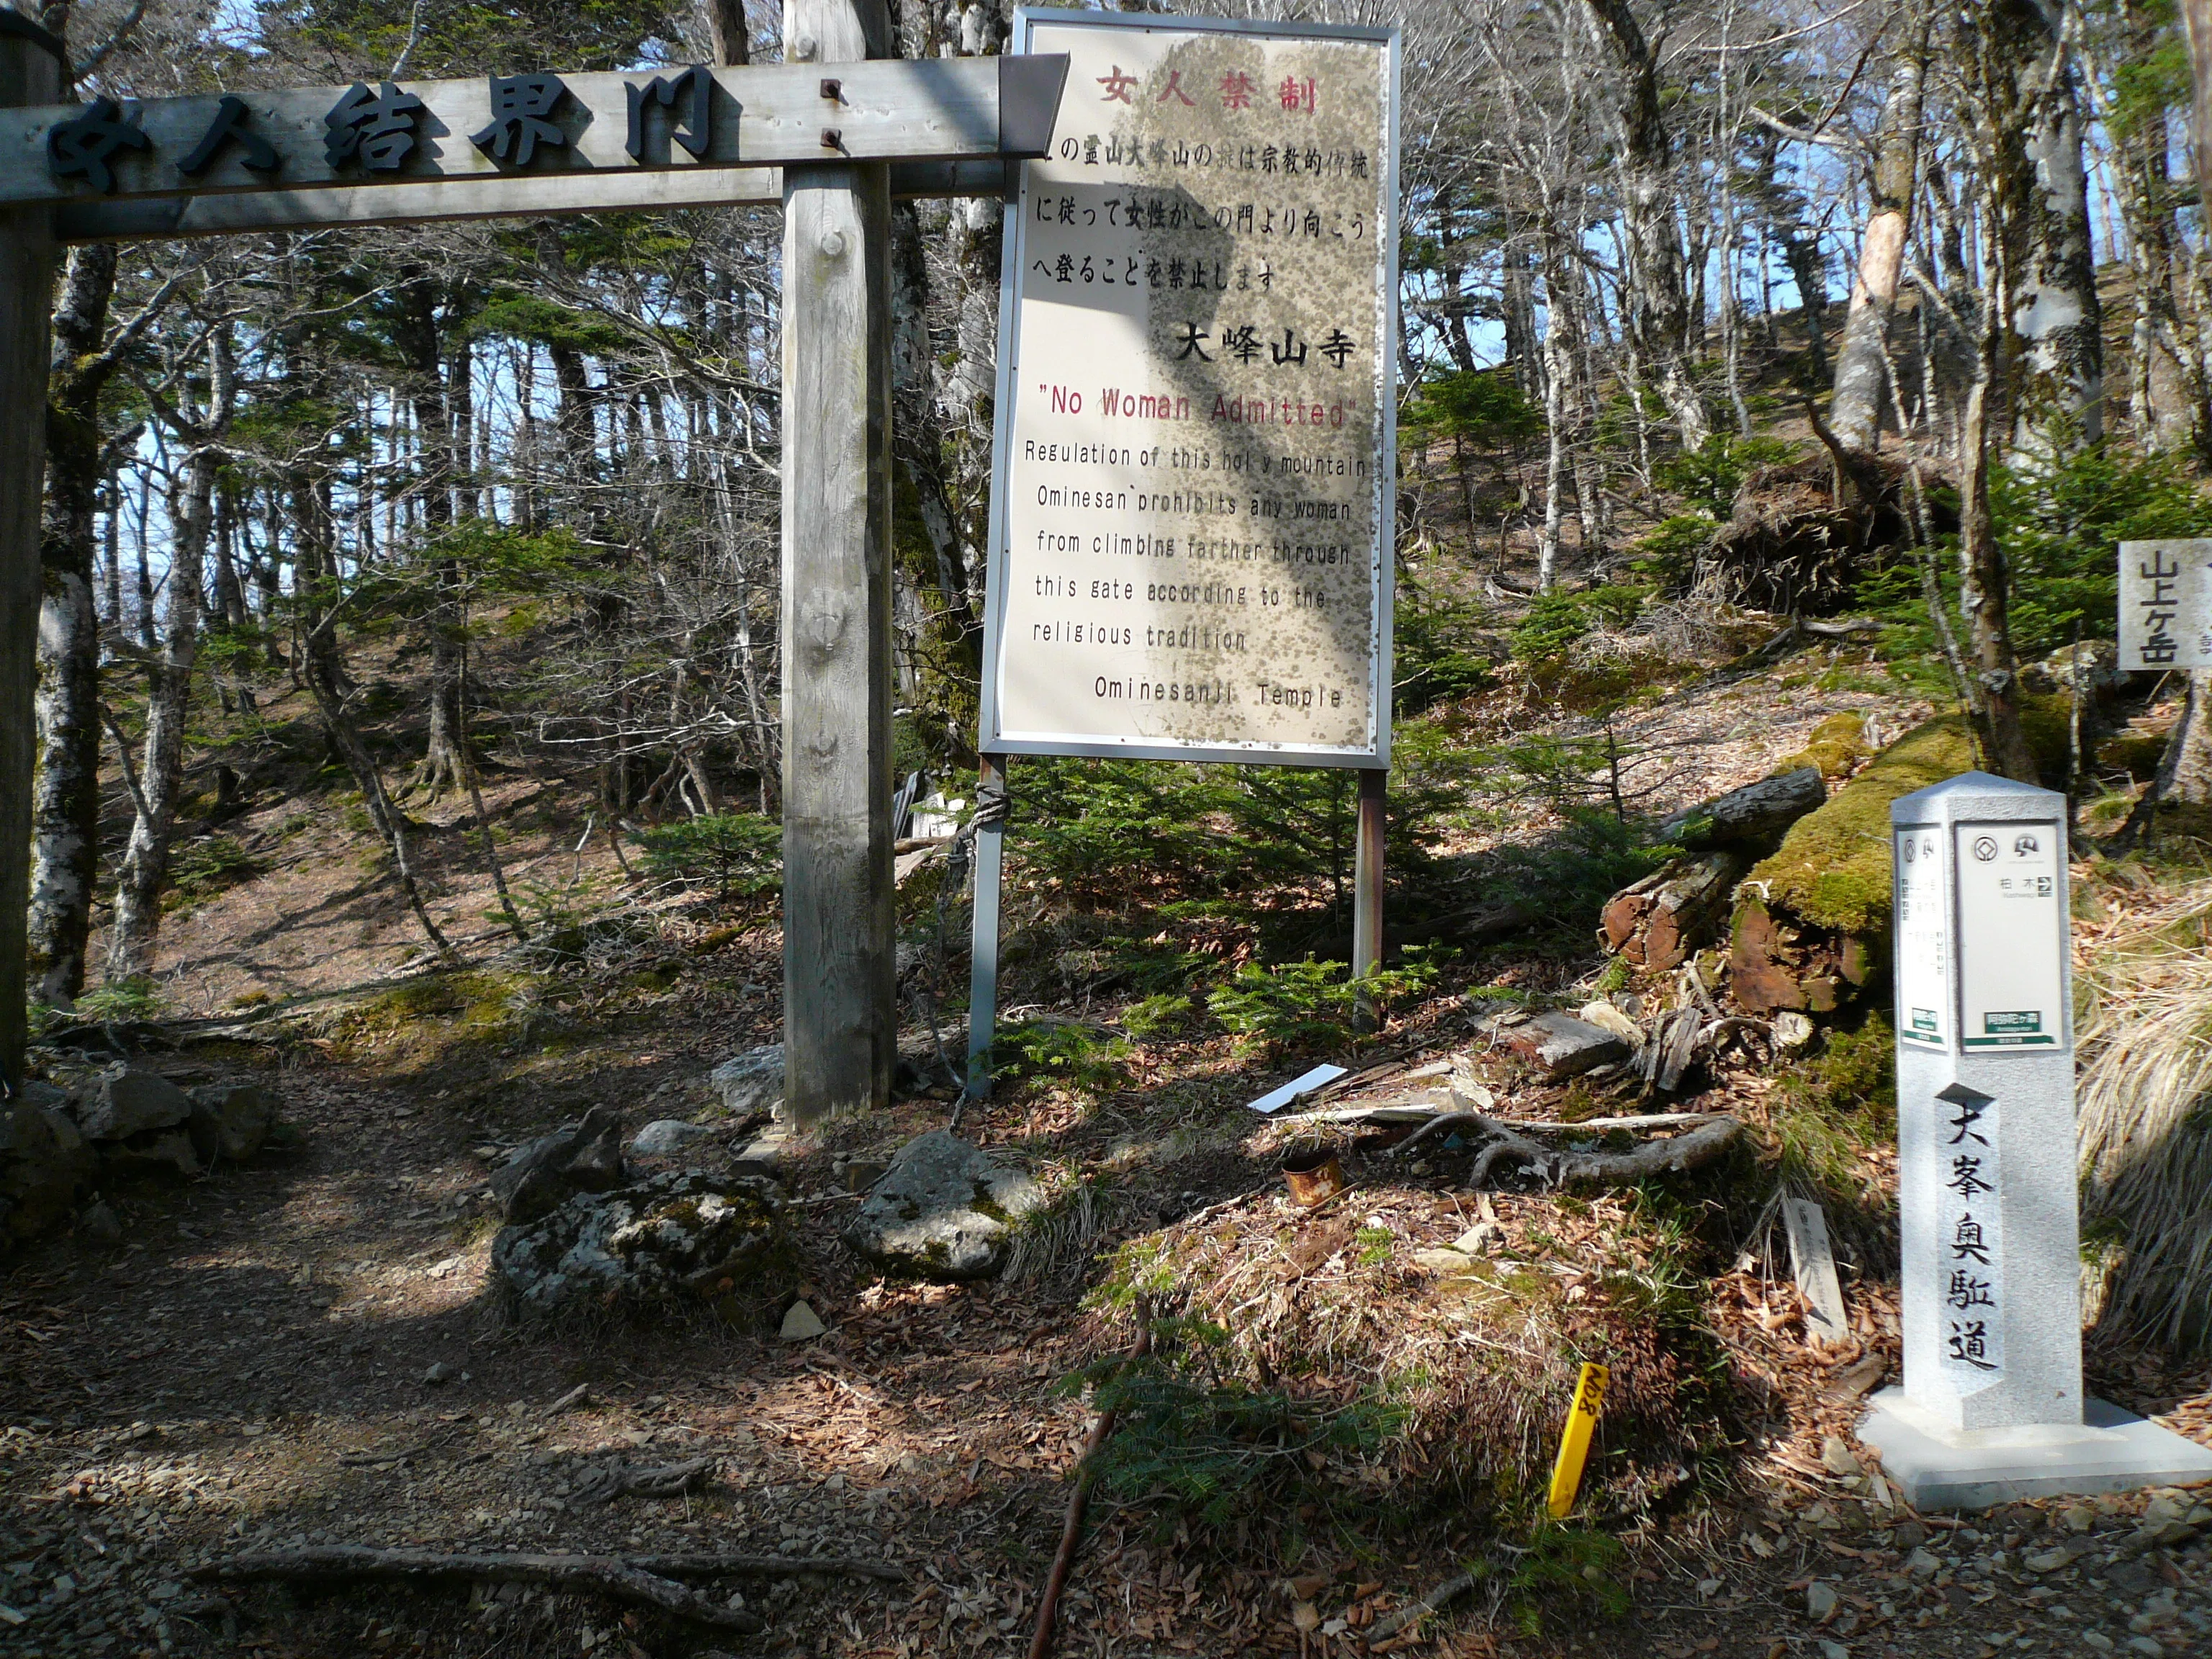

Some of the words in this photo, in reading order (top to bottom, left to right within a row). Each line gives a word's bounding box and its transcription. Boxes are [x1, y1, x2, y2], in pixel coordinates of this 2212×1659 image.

[1095, 65, 1316, 114] 女人禁制
[48, 65, 714, 196] 女人結界門
[1036, 195, 1363, 240] に従って女性がこの門より向こう
[1033, 253, 1274, 292] へ登ることを禁止します
[1176, 323, 1357, 369] 大峰山寺
[1102, 388, 1190, 421] Woman
[1025, 440, 1130, 465] Regulation
[1140, 446, 1160, 467] of
[1172, 447, 1210, 469] this
[1282, 456, 1365, 477] mountain
[1038, 485, 1126, 510] Ominesan
[1138, 490, 1236, 516] prohibits
[1250, 498, 1282, 519] any
[1295, 502, 1350, 521] woman
[1038, 531, 1079, 553] from
[1092, 534, 1174, 559] climbing
[1187, 537, 1262, 561] farther
[1273, 541, 1349, 565] through
[1035, 575, 1076, 597] this
[1091, 578, 1133, 600] gate
[1148, 582, 1246, 606] according
[1262, 586, 1280, 606] to
[1295, 586, 1325, 608] the
[1033, 621, 1131, 644] religious
[1147, 625, 1245, 649] tradition
[1095, 675, 1232, 704] Ominesanji
[1257, 683, 1341, 708] Temple
